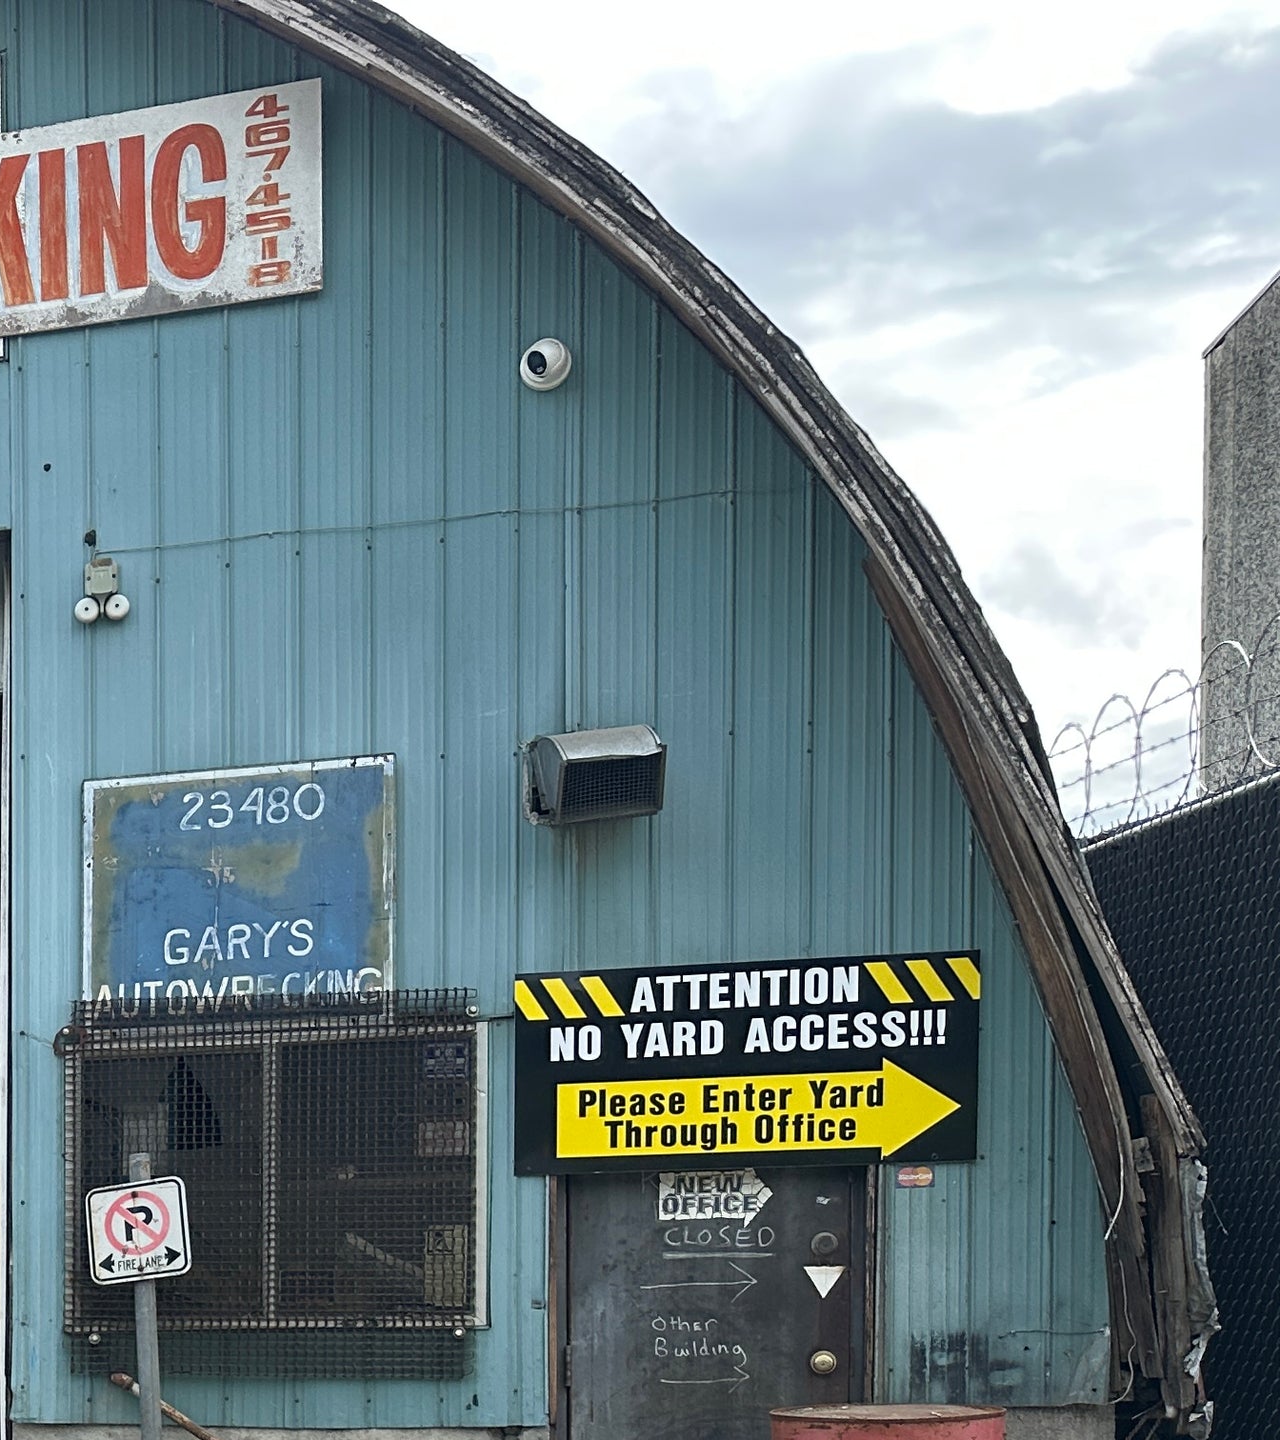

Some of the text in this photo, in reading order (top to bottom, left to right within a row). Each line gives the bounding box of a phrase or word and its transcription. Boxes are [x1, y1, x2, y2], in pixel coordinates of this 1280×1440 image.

[179, 783, 326, 831] 23480
[163, 919, 314, 966] GARY'S
[629, 966, 860, 1014] ATTENTION
[549, 1009, 947, 1063] NO YARD ACCESS!!!
[578, 1078, 885, 1118] Please Enter Yard
[604, 1114, 857, 1152] Through Office
[675, 1174, 741, 1193] NEW
[662, 1194, 761, 1215] OFFICE
[664, 1225, 775, 1248] CLOSED
[117, 1258, 137, 1272] FIRE
[654, 1337, 747, 1367] Building
